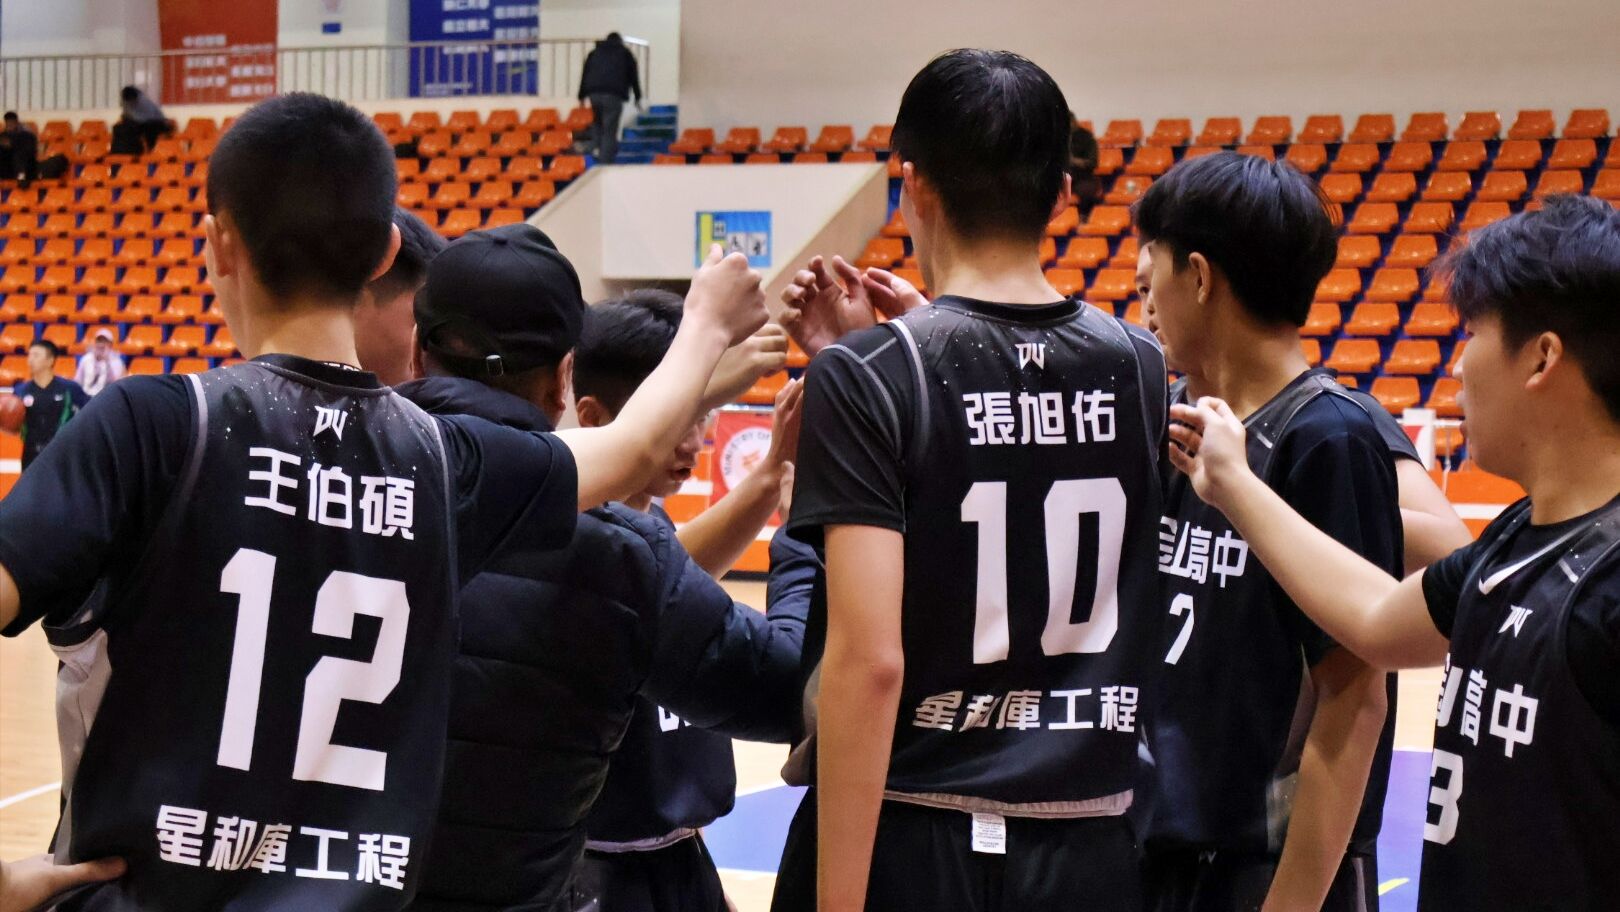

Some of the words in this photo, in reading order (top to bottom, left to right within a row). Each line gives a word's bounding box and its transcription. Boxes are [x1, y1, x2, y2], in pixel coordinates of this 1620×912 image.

[962, 388, 1116, 446] 張旭佑
[244, 447, 415, 541] 王伯碩
[960, 477, 1127, 665] 10
[216, 547, 411, 792] 12
[1164, 592, 1195, 666] 7
[156, 804, 411, 891] 星和庫工程
